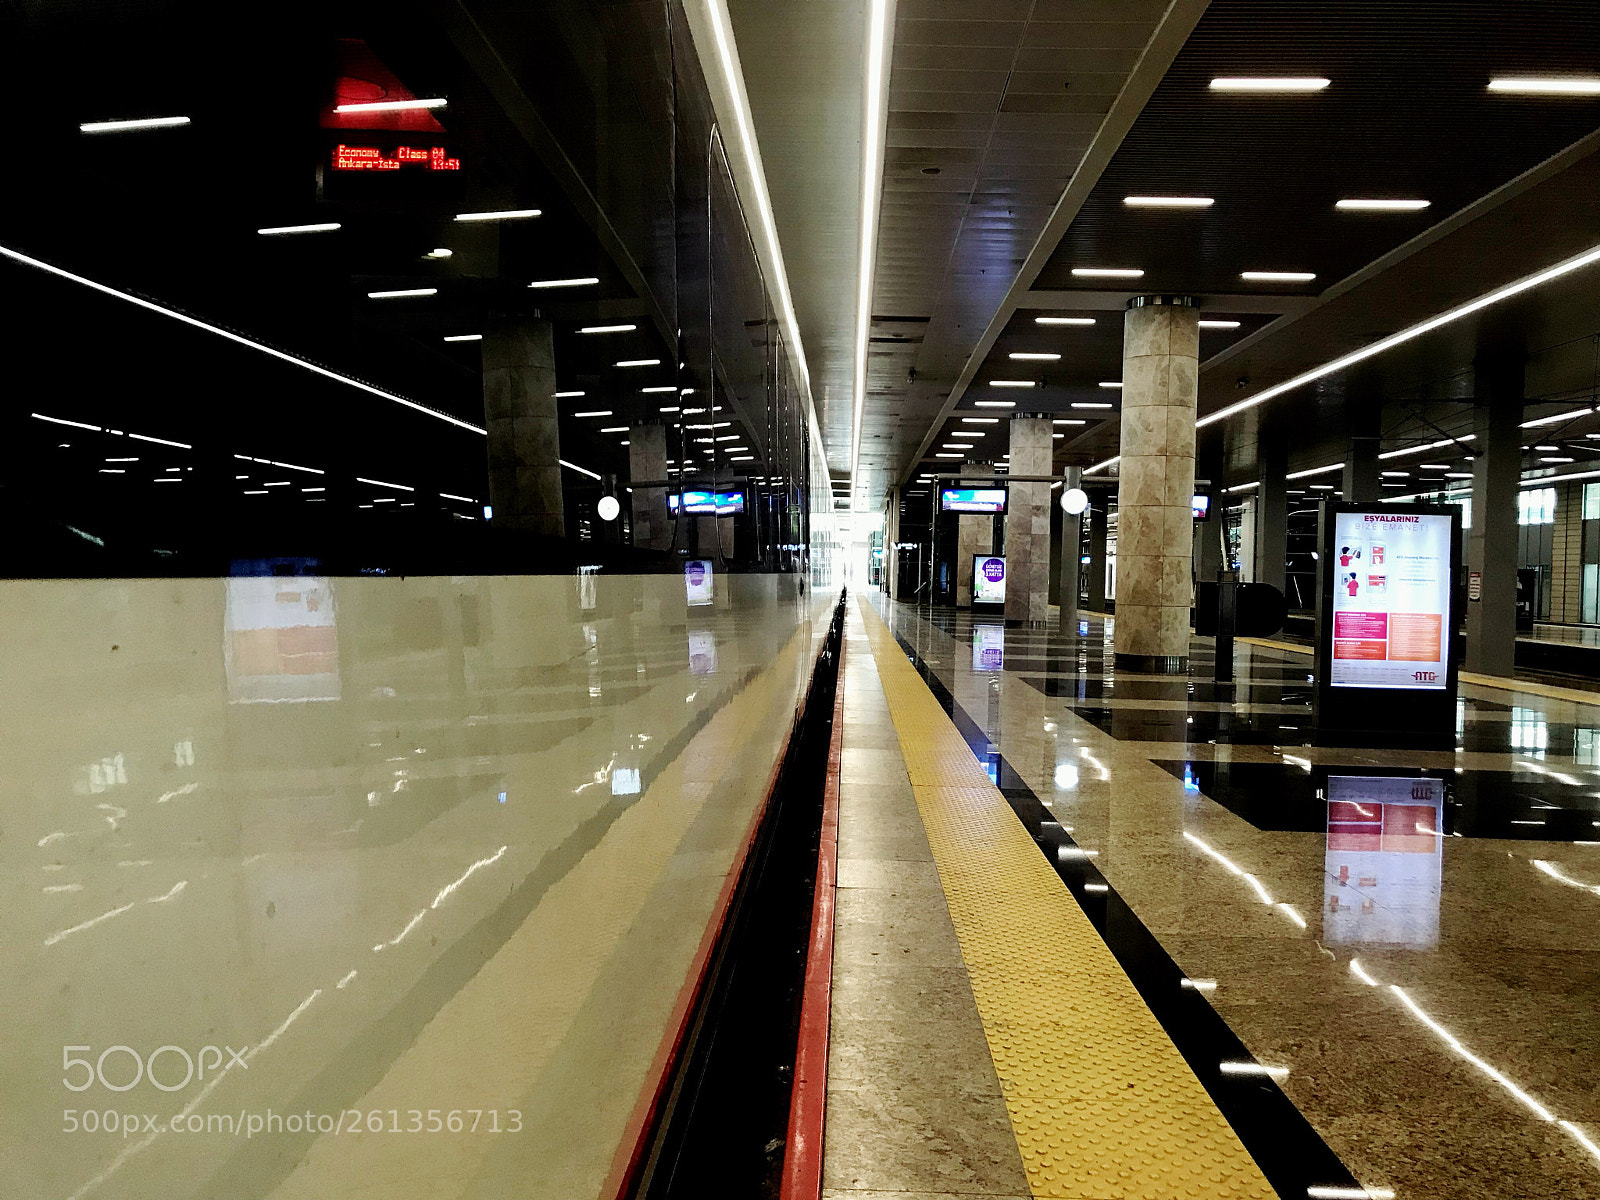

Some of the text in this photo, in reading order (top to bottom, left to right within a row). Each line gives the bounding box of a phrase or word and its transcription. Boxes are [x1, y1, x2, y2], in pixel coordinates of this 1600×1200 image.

[339, 145, 379, 157] Economy
[399, 147, 428, 159] Class
[1364, 515, 1420, 523] EŞYALARINIZ
